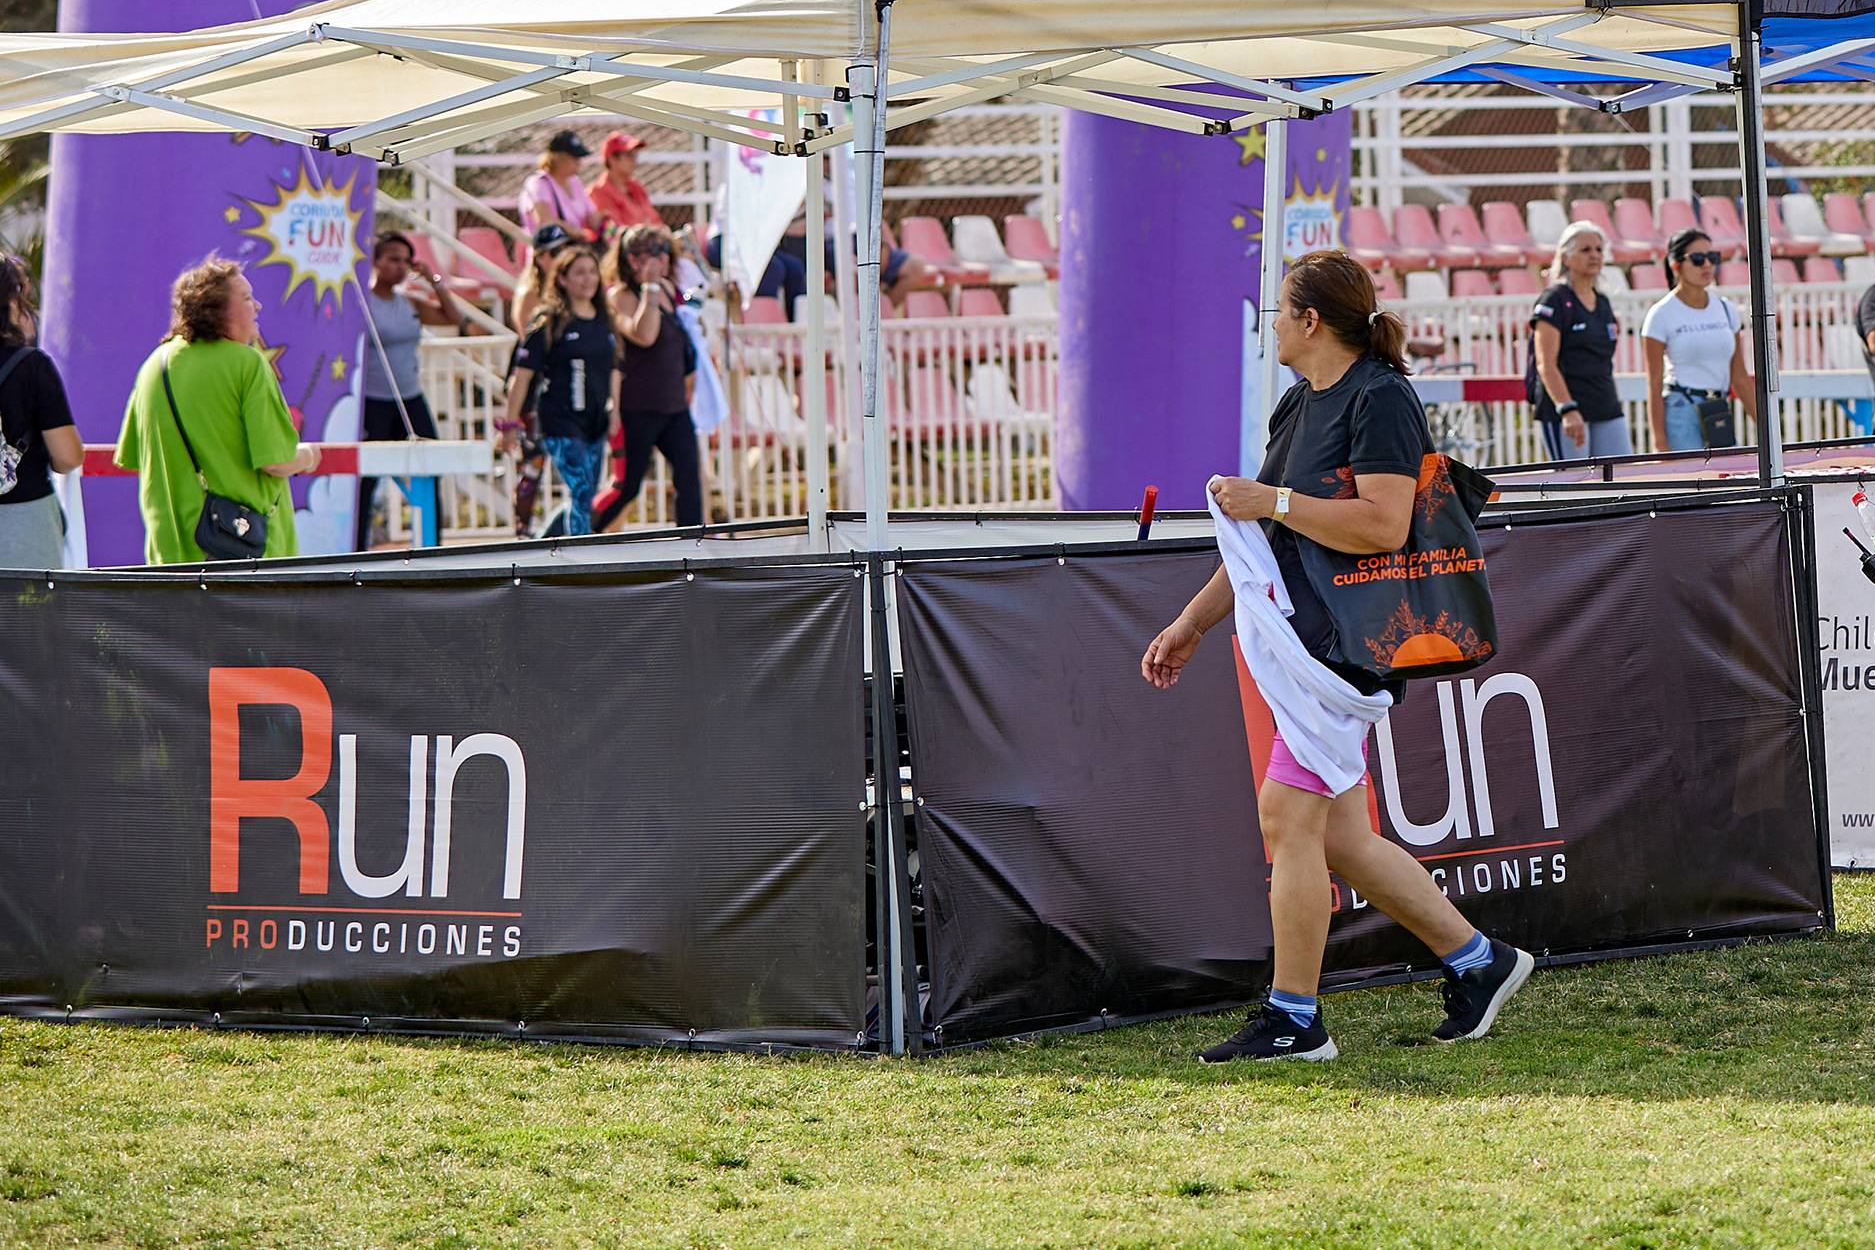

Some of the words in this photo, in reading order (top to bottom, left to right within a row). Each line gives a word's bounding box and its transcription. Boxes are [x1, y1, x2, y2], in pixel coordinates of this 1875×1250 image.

[288, 218, 345, 248] FUN
[1286, 222, 1332, 248] FUN
[1333, 567, 1407, 586] CUIDAMOS
[1409, 567, 1428, 580] EL
[1431, 558, 1488, 576] PLANET
[1357, 555, 1391, 571] CON
[1394, 554, 1406, 566] MI
[1409, 546, 1467, 566] FAMILIA
[209, 667, 527, 900] Run
[206, 918, 523, 957] PRODUCCIONES
